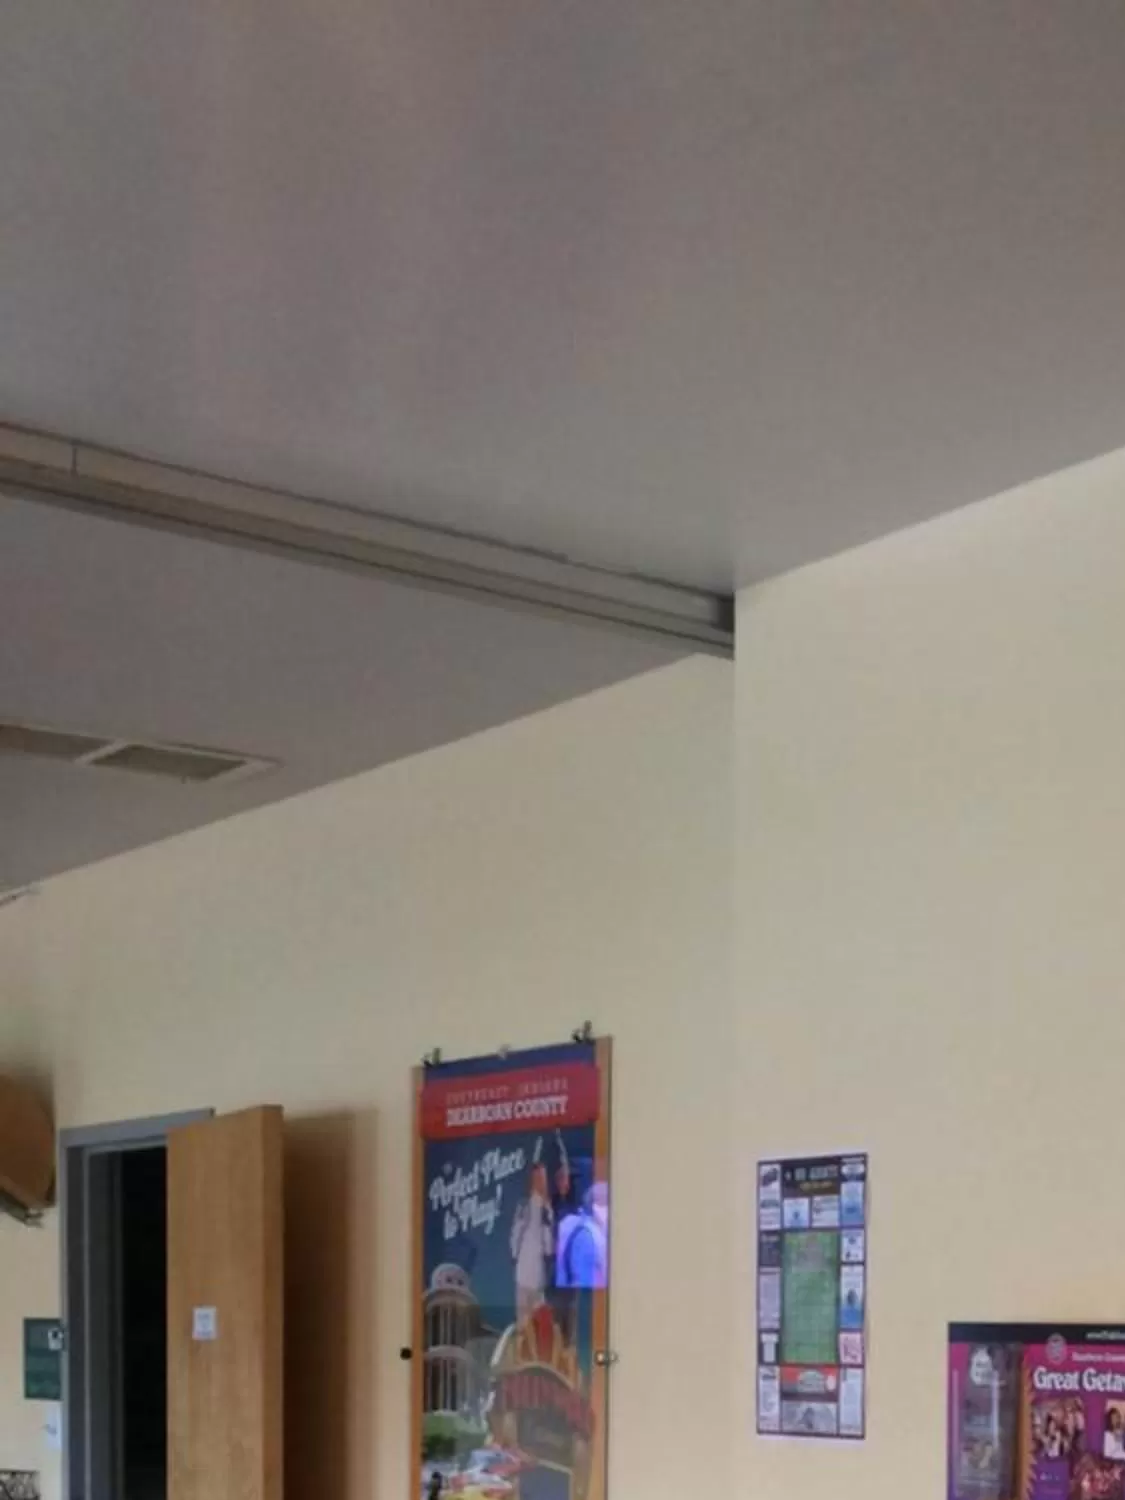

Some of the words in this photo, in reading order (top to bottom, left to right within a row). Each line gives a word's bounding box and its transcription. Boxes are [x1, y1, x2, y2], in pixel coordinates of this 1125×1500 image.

[514, 1094, 569, 1119] COUNTY
[480, 1148, 527, 1185] Place
[1033, 1366, 1080, 1391] Great
